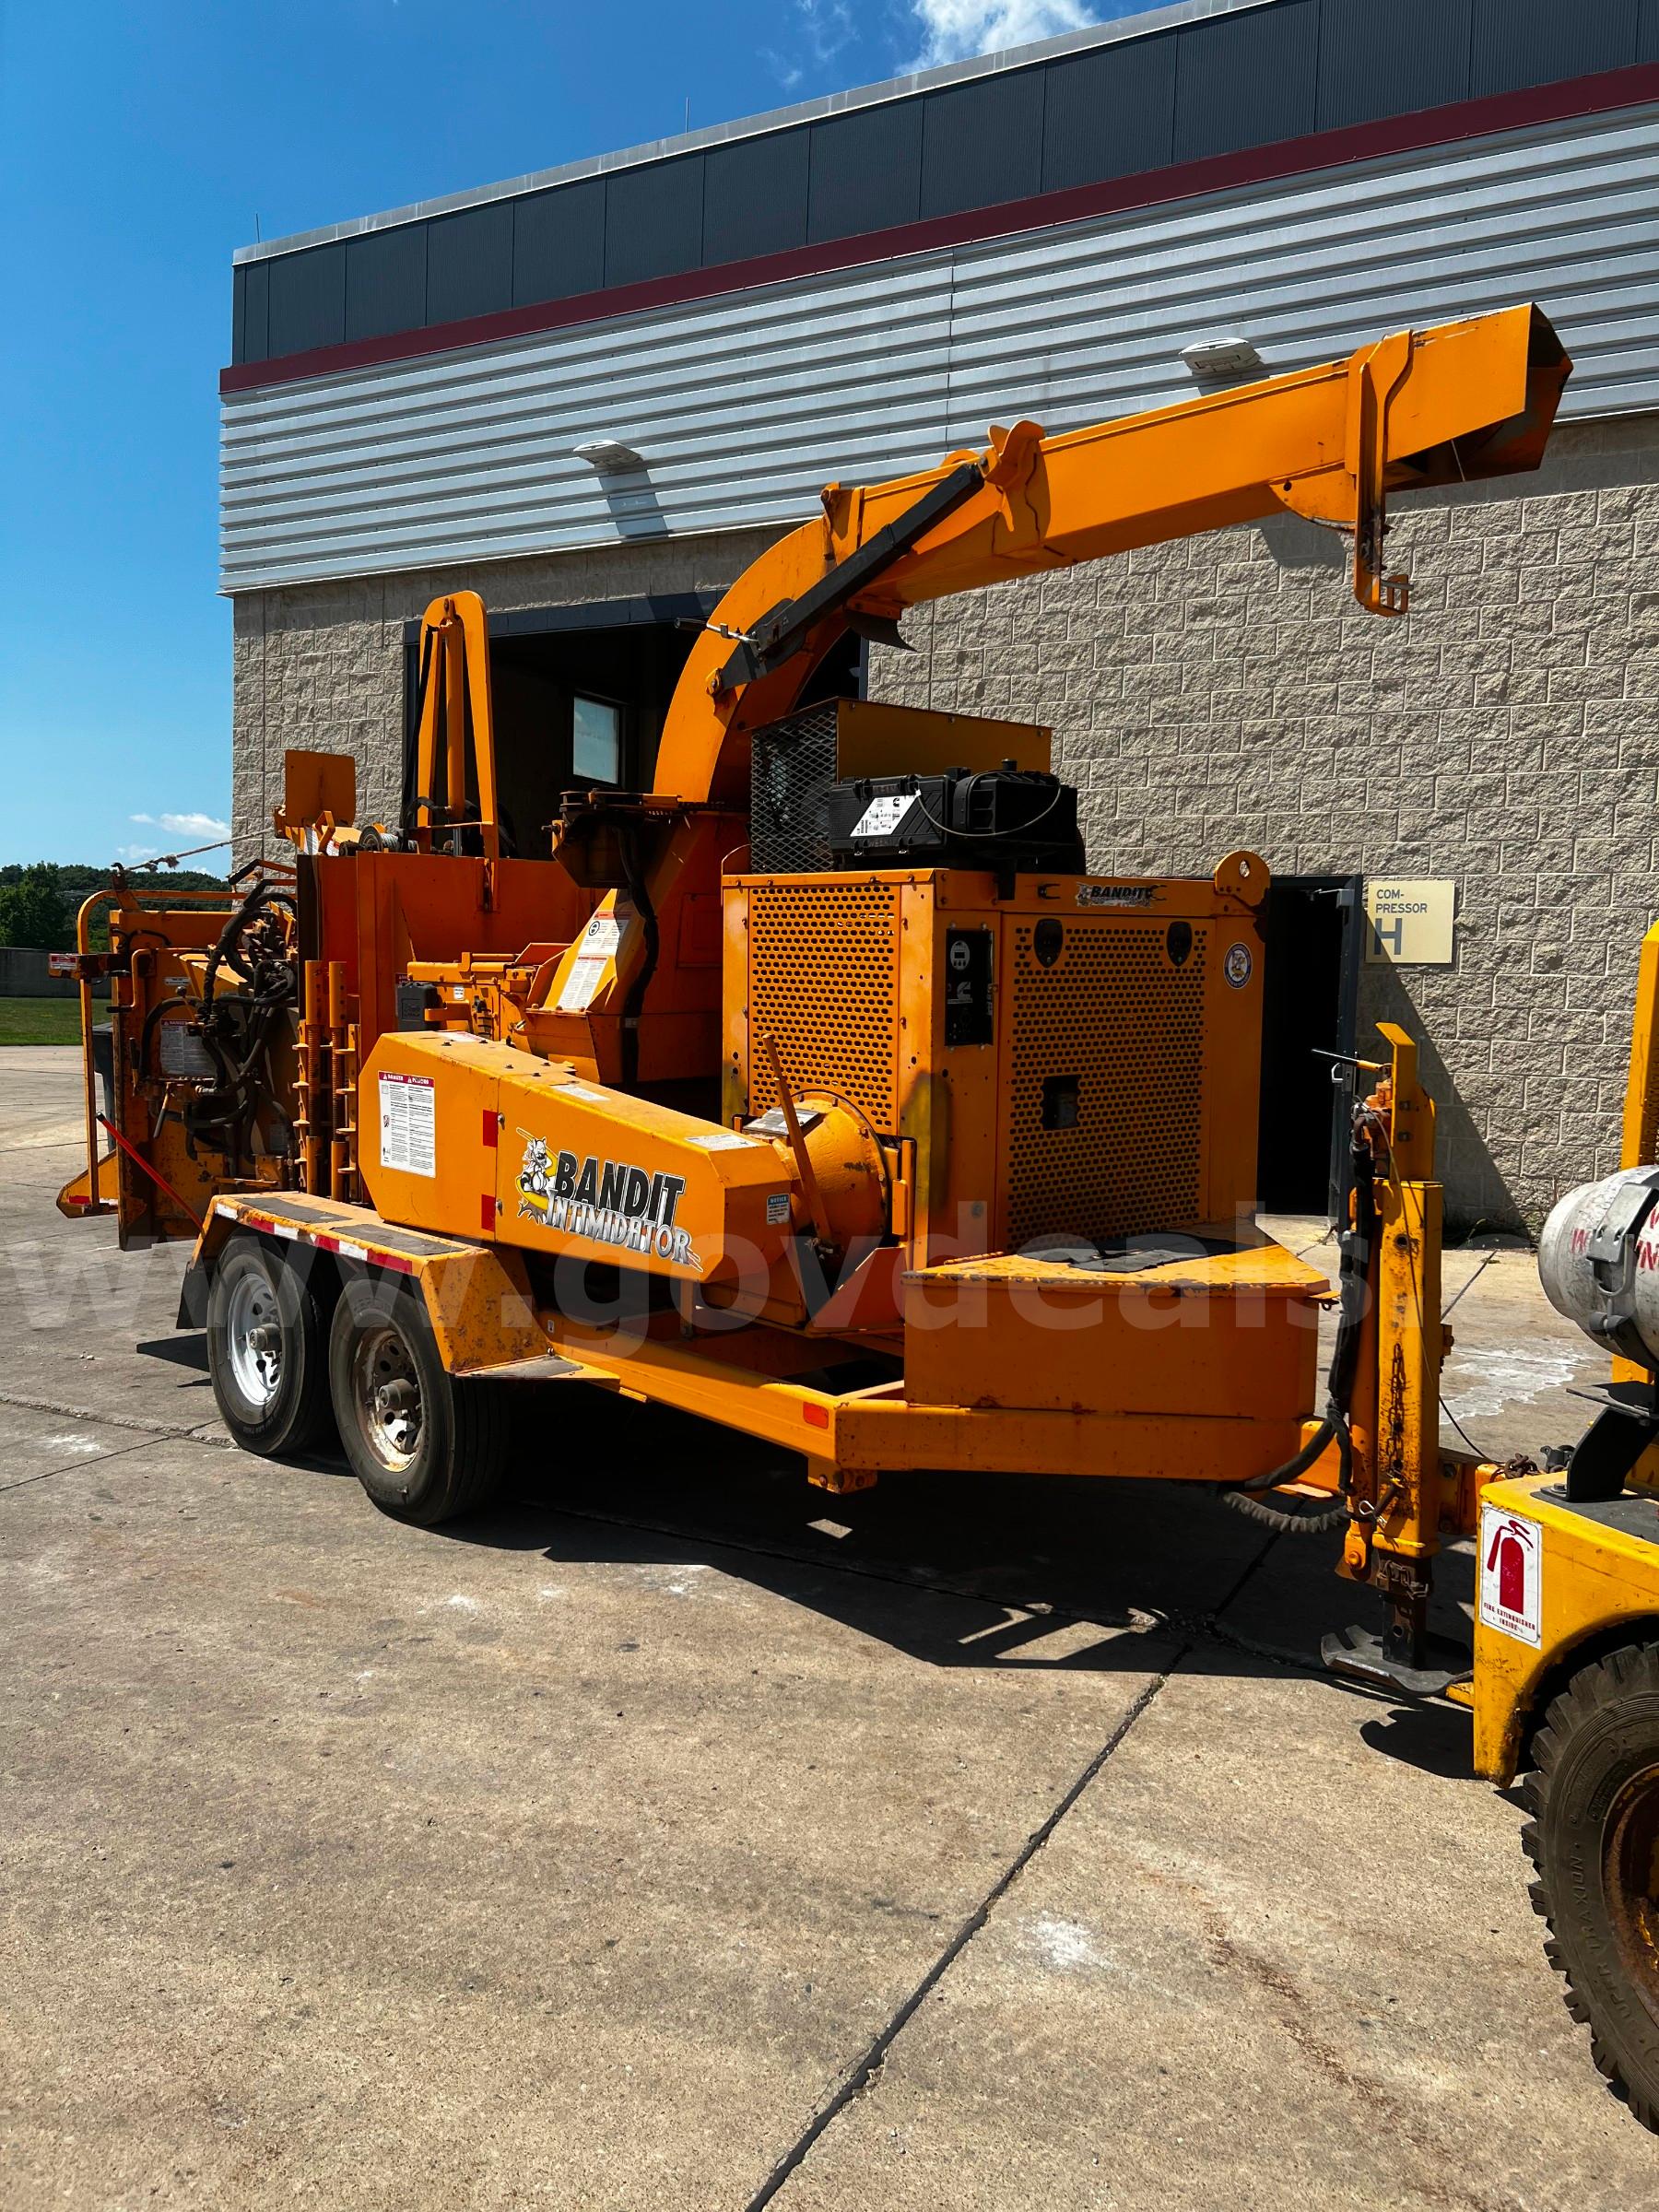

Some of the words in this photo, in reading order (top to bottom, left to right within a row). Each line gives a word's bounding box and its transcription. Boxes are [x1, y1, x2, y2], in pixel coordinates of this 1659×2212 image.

[1375, 903, 1428, 913] PRESSOR
[1376, 888, 1405, 900] COM-
[1373, 917, 1403, 955] H
[554, 1149, 687, 1229] BANDIT
[545, 1187, 692, 1265] INTIMIDATOR
[1483, 1602, 1495, 1612] FIRE
[1497, 1608, 1535, 1630] EXTINGUISHER
[1499, 1618, 1518, 1630] INSIDE
